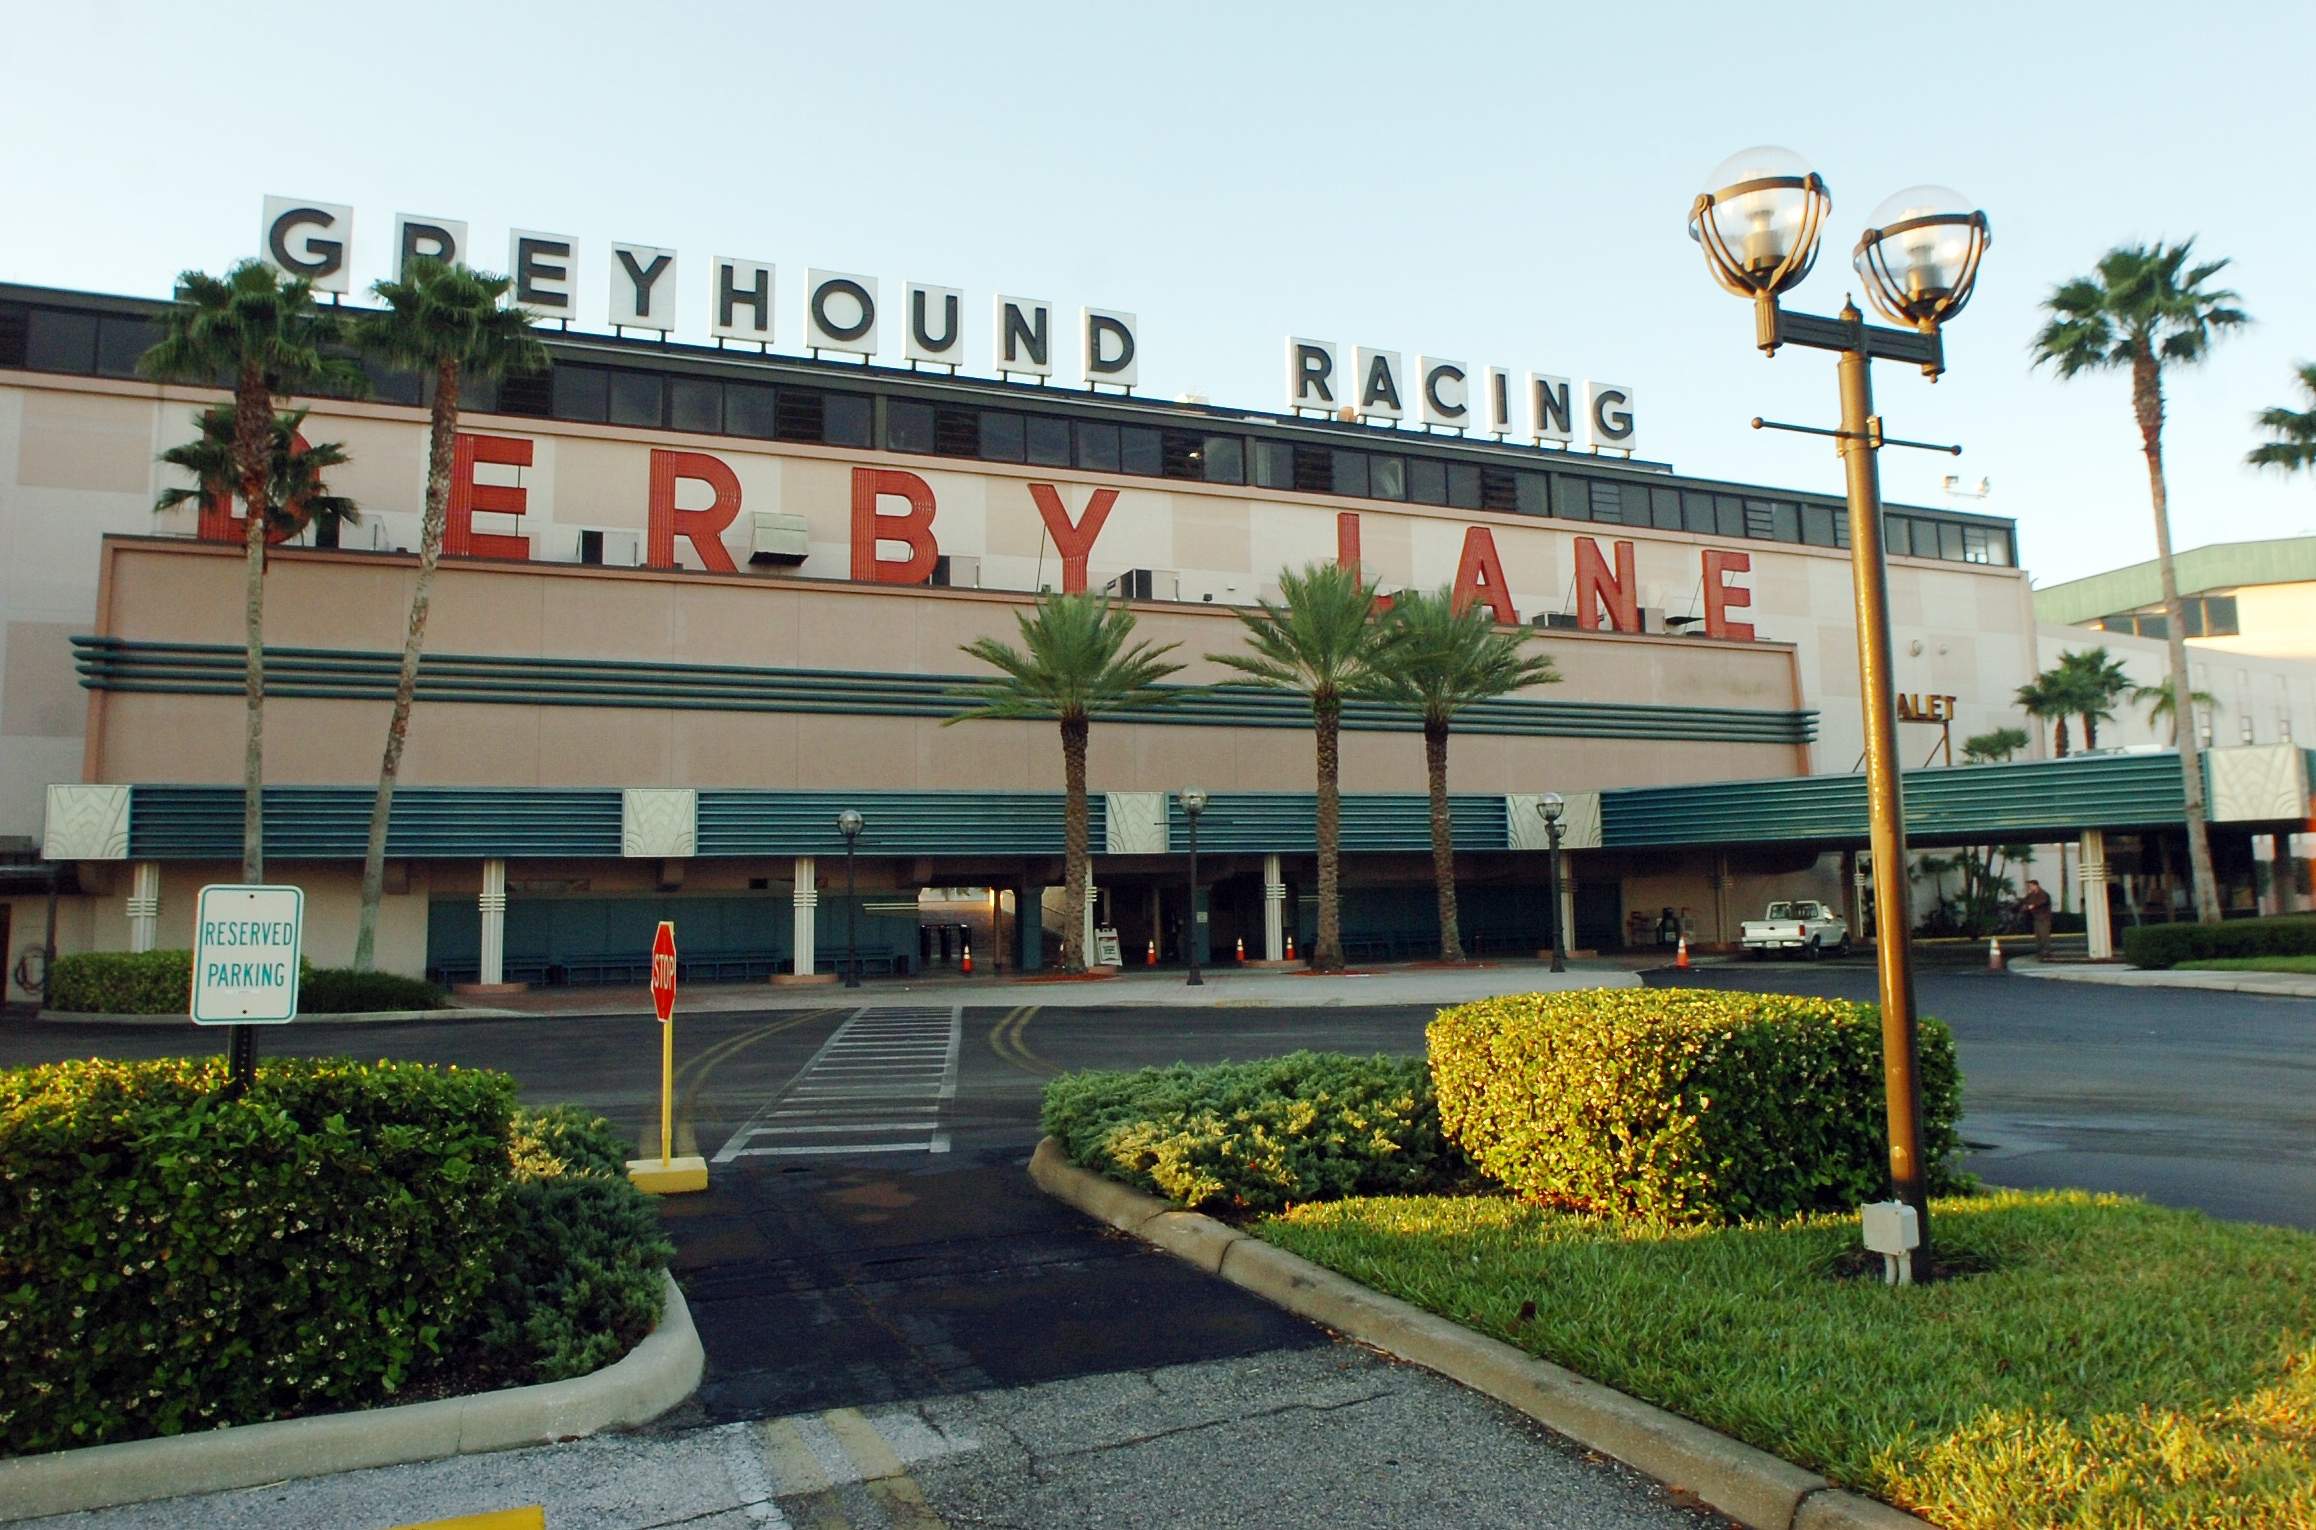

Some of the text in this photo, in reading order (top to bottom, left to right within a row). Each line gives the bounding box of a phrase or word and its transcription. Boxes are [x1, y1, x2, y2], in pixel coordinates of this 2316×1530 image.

[1296, 343, 1634, 440] RACING
[1337, 512, 1756, 641] LANE
[1896, 693, 1957, 720] ALET
[205, 922, 293, 946] RESERVED
[207, 963, 285, 987] PARKING
[654, 953, 675, 990] STOP
